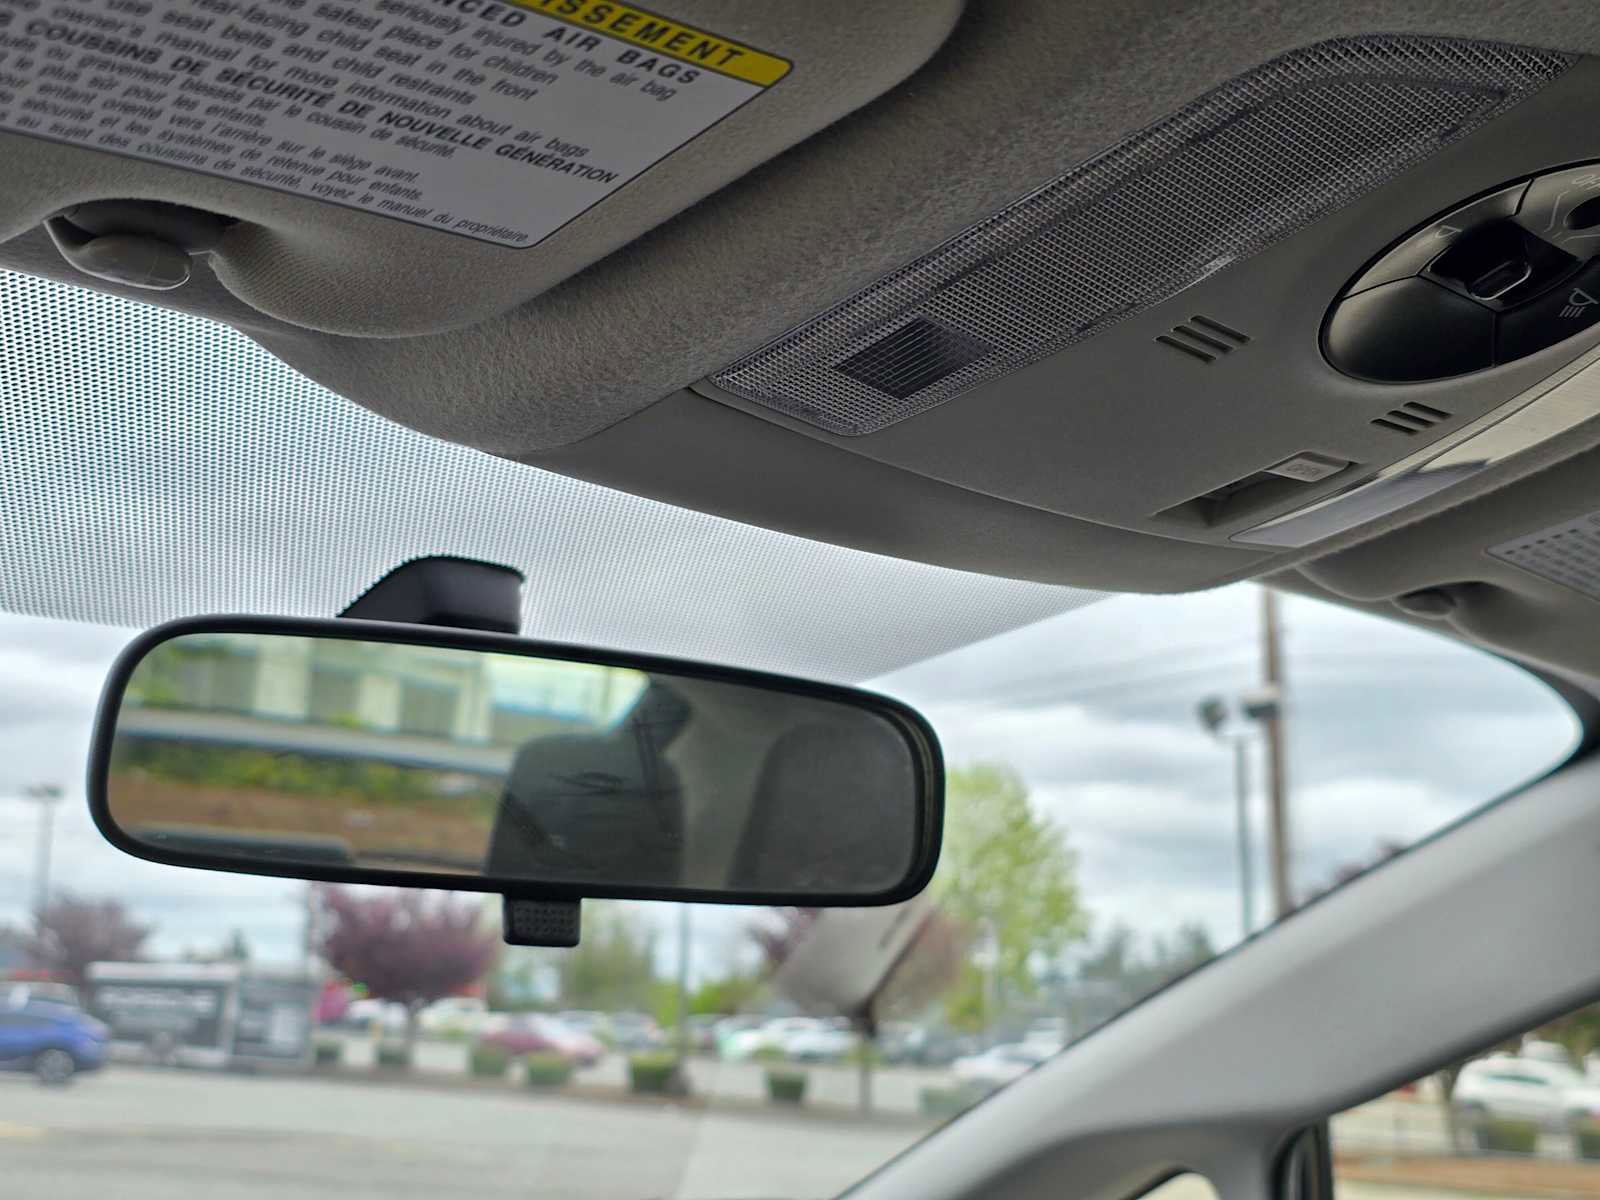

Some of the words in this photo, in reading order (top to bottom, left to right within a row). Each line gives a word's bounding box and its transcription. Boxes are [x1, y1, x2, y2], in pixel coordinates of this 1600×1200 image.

[161, 11, 215, 33] seat
[220, 24, 275, 49] belts
[282, 44, 329, 63] and
[332, 57, 386, 78] child
[388, 73, 476, 105] restraints
[314, 4, 382, 32] safest
[382, 26, 443, 50] place
[448, 42, 479, 60] for
[482, 56, 558, 85] children
[317, 30, 372, 51] child
[373, 46, 422, 67] seat
[425, 60, 447, 75] in
[453, 68, 486, 85] the
[491, 79, 538, 101] front
[472, 27, 543, 56] injured
[543, 48, 571, 67] by
[574, 59, 606, 77] the
[609, 73, 639, 86] air
[640, 80, 677, 101] bag
[543, 27, 601, 51] AIR
[616, 50, 700, 83] BAGS
[25, 20, 162, 64] COUSSINS
[170, 56, 208, 76] DE
[338, 100, 374, 118] DE
[378, 111, 492, 149] NOUVELLE
[495, 144, 618, 183] GÉNÉRATION
[155, 32, 241, 62] manual
[246, 54, 278, 72] for
[284, 67, 339, 88] more
[346, 82, 451, 119] information
[456, 115, 512, 136] about
[514, 131, 542, 146] air
[544, 138, 589, 157] bags
[283, 105, 302, 118] le
[306, 112, 367, 134] coussin
[370, 129, 392, 140] de
[240, 148, 262, 161] de
[266, 156, 326, 176] retenue
[326, 171, 366, 185] pour
[276, 141, 305, 154] sur
[308, 146, 326, 160] le
[213, 160, 236, 170] de
[358, 192, 374, 204] le
[377, 200, 433, 218] manuel
[433, 213, 454, 224] du
